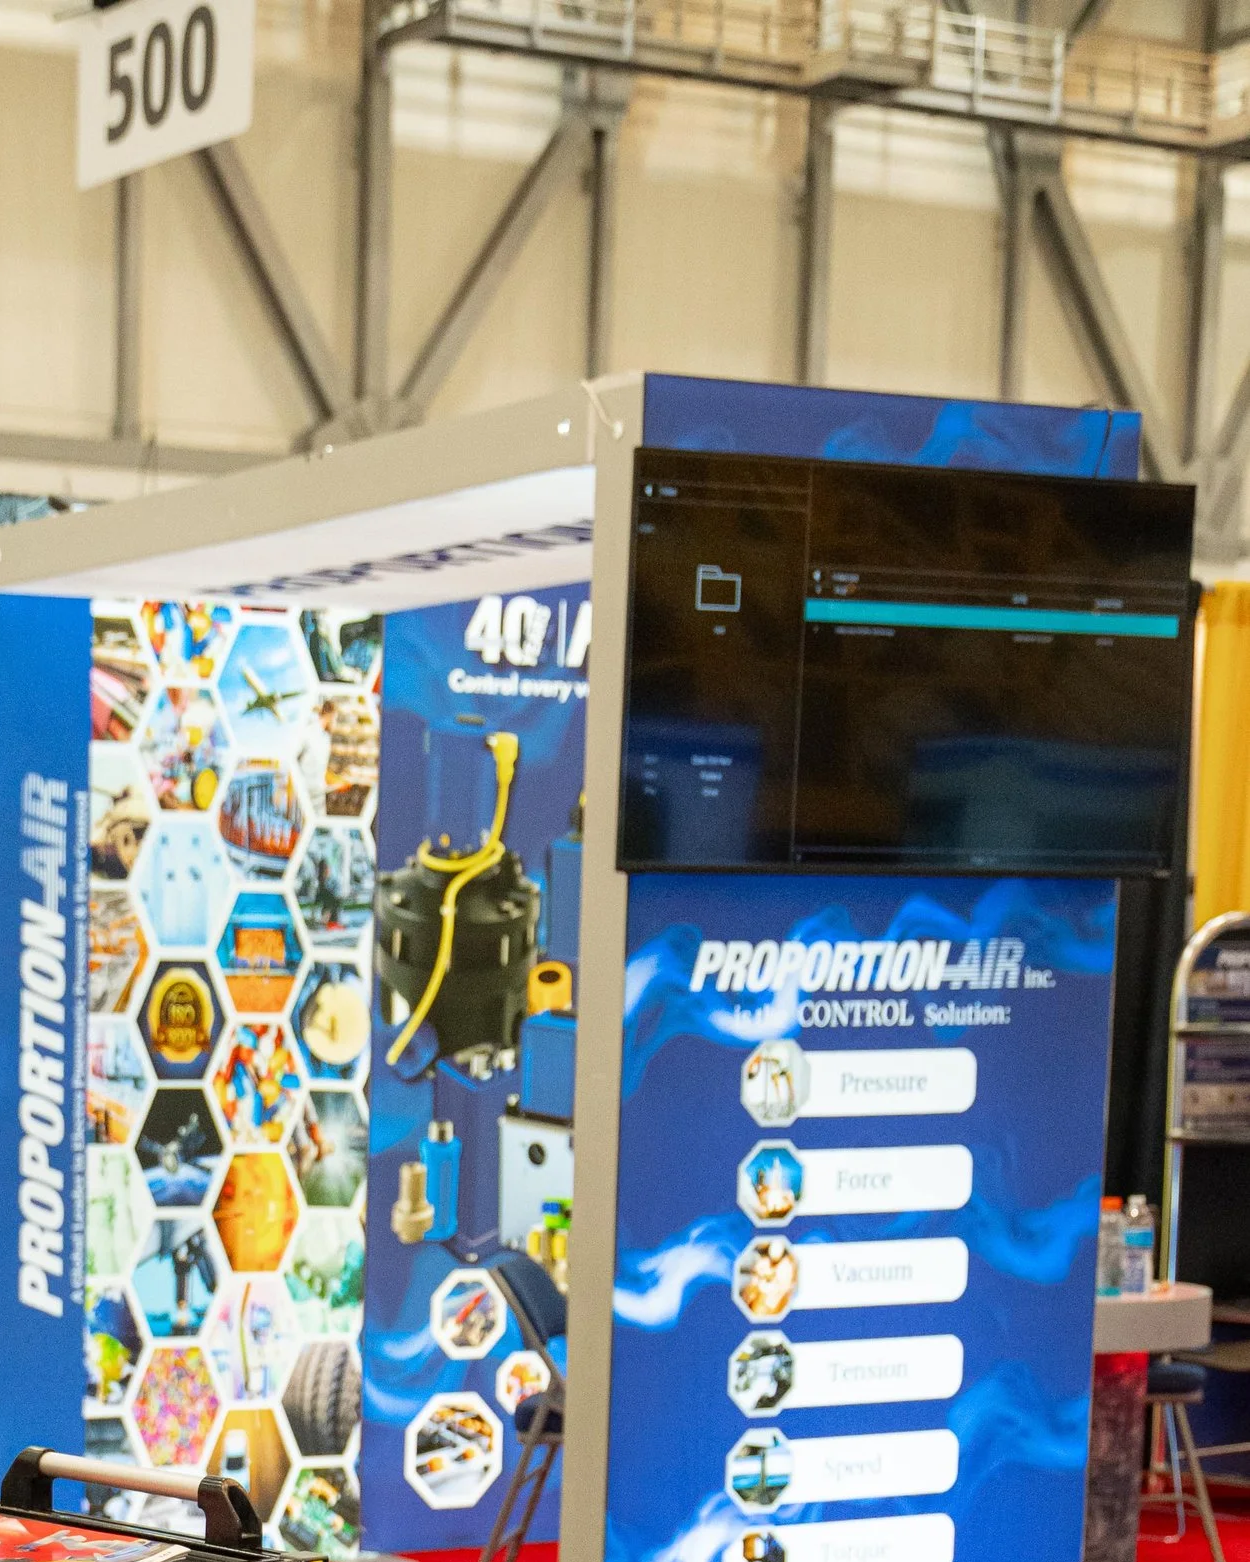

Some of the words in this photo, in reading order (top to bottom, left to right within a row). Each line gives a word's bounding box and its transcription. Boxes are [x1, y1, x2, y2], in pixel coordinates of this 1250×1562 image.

[106, 5, 216, 144] 500
[449, 668, 519, 697] Control
[520, 678, 572, 704] every
[799, 999, 914, 1028] CONTROL
[923, 1002, 1012, 1027] Solution:
[840, 1071, 928, 1094] Pressure
[836, 1168, 892, 1191] Force
[832, 1261, 914, 1284] Vacuum
[827, 1361, 909, 1383] Tension
[824, 1455, 882, 1482] Speed
